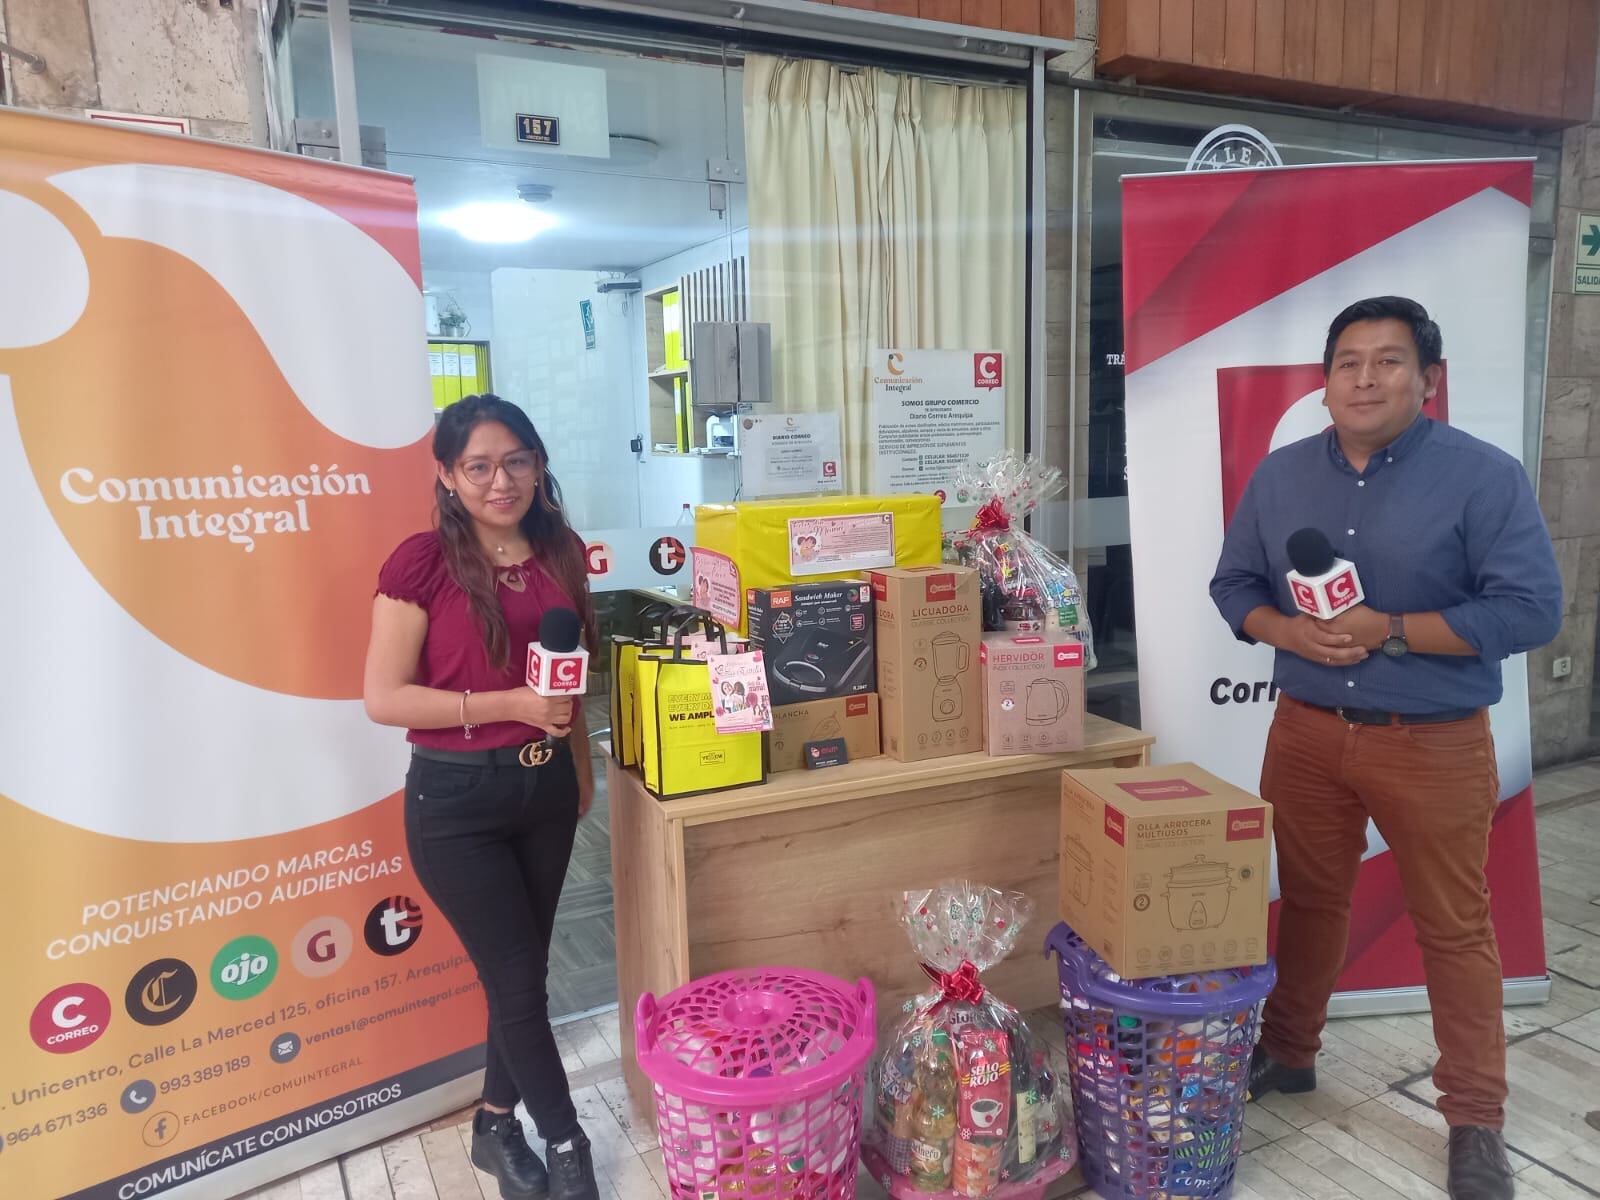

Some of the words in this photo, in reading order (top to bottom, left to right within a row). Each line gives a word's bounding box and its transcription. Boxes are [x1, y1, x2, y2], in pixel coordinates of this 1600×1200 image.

[523, 118, 551, 135] 157
[1577, 275, 1600, 285] SALID
[980, 356, 997, 379] C
[885, 384, 912, 394] Integral
[60, 464, 371, 504] Comunicación
[137, 499, 311, 552] Integral
[582, 545, 608, 575] G
[658, 542, 677, 570] t
[772, 597, 790, 605] RAF
[794, 594, 823, 602] Sandwich
[824, 591, 843, 599] Maker
[1297, 586, 1313, 604] C
[1332, 577, 1351, 598] C
[912, 605, 969, 617] LICUADORA
[993, 652, 1045, 663] HERVIDOR
[556, 660, 576, 681] C
[668, 694, 699, 703] EVERY
[668, 703, 699, 712] EVERY
[669, 713, 686, 721] WE
[1137, 823, 1162, 832] OLLA
[1163, 819, 1212, 829] ARROCERA
[1137, 828, 1189, 839] MULTIUSOS
[81, 864, 270, 925] POTENCIANDO
[277, 839, 373, 878] MARCAS
[46, 891, 263, 960] CONQUISTANDO
[269, 856, 403, 904] AUDIENCIAS
[1139, 898, 1145, 907] 2
[307, 930, 336, 963] G
[220, 952, 269, 986] ojo
[52, 996, 86, 1029] C
[47, 1024, 98, 1046] CORREO
[11, 1065, 124, 1106] Unicentro,
[128, 1044, 176, 1069] Calle
[181, 1033, 203, 1052] La
[207, 1011, 276, 1044] Merced
[280, 1002, 312, 1022] 125,
[315, 986, 370, 1011] oficina
[160, 1073, 190, 1095] 993
[193, 1063, 223, 1085] 389
[226, 1054, 250, 1074] 189
[970, 1062, 999, 1077] SELLO
[183, 1056, 363, 1126] FACEBOOK/COMUINTEGRAL
[970, 1072, 999, 1089] ROJO
[6, 1123, 42, 1146] 964
[45, 1112, 73, 1134] 671
[76, 1103, 108, 1124] 336
[118, 1136, 257, 1200] COMUNÍCATE
[260, 1119, 303, 1147] CON
[305, 1083, 402, 1131] NOSOTROS
